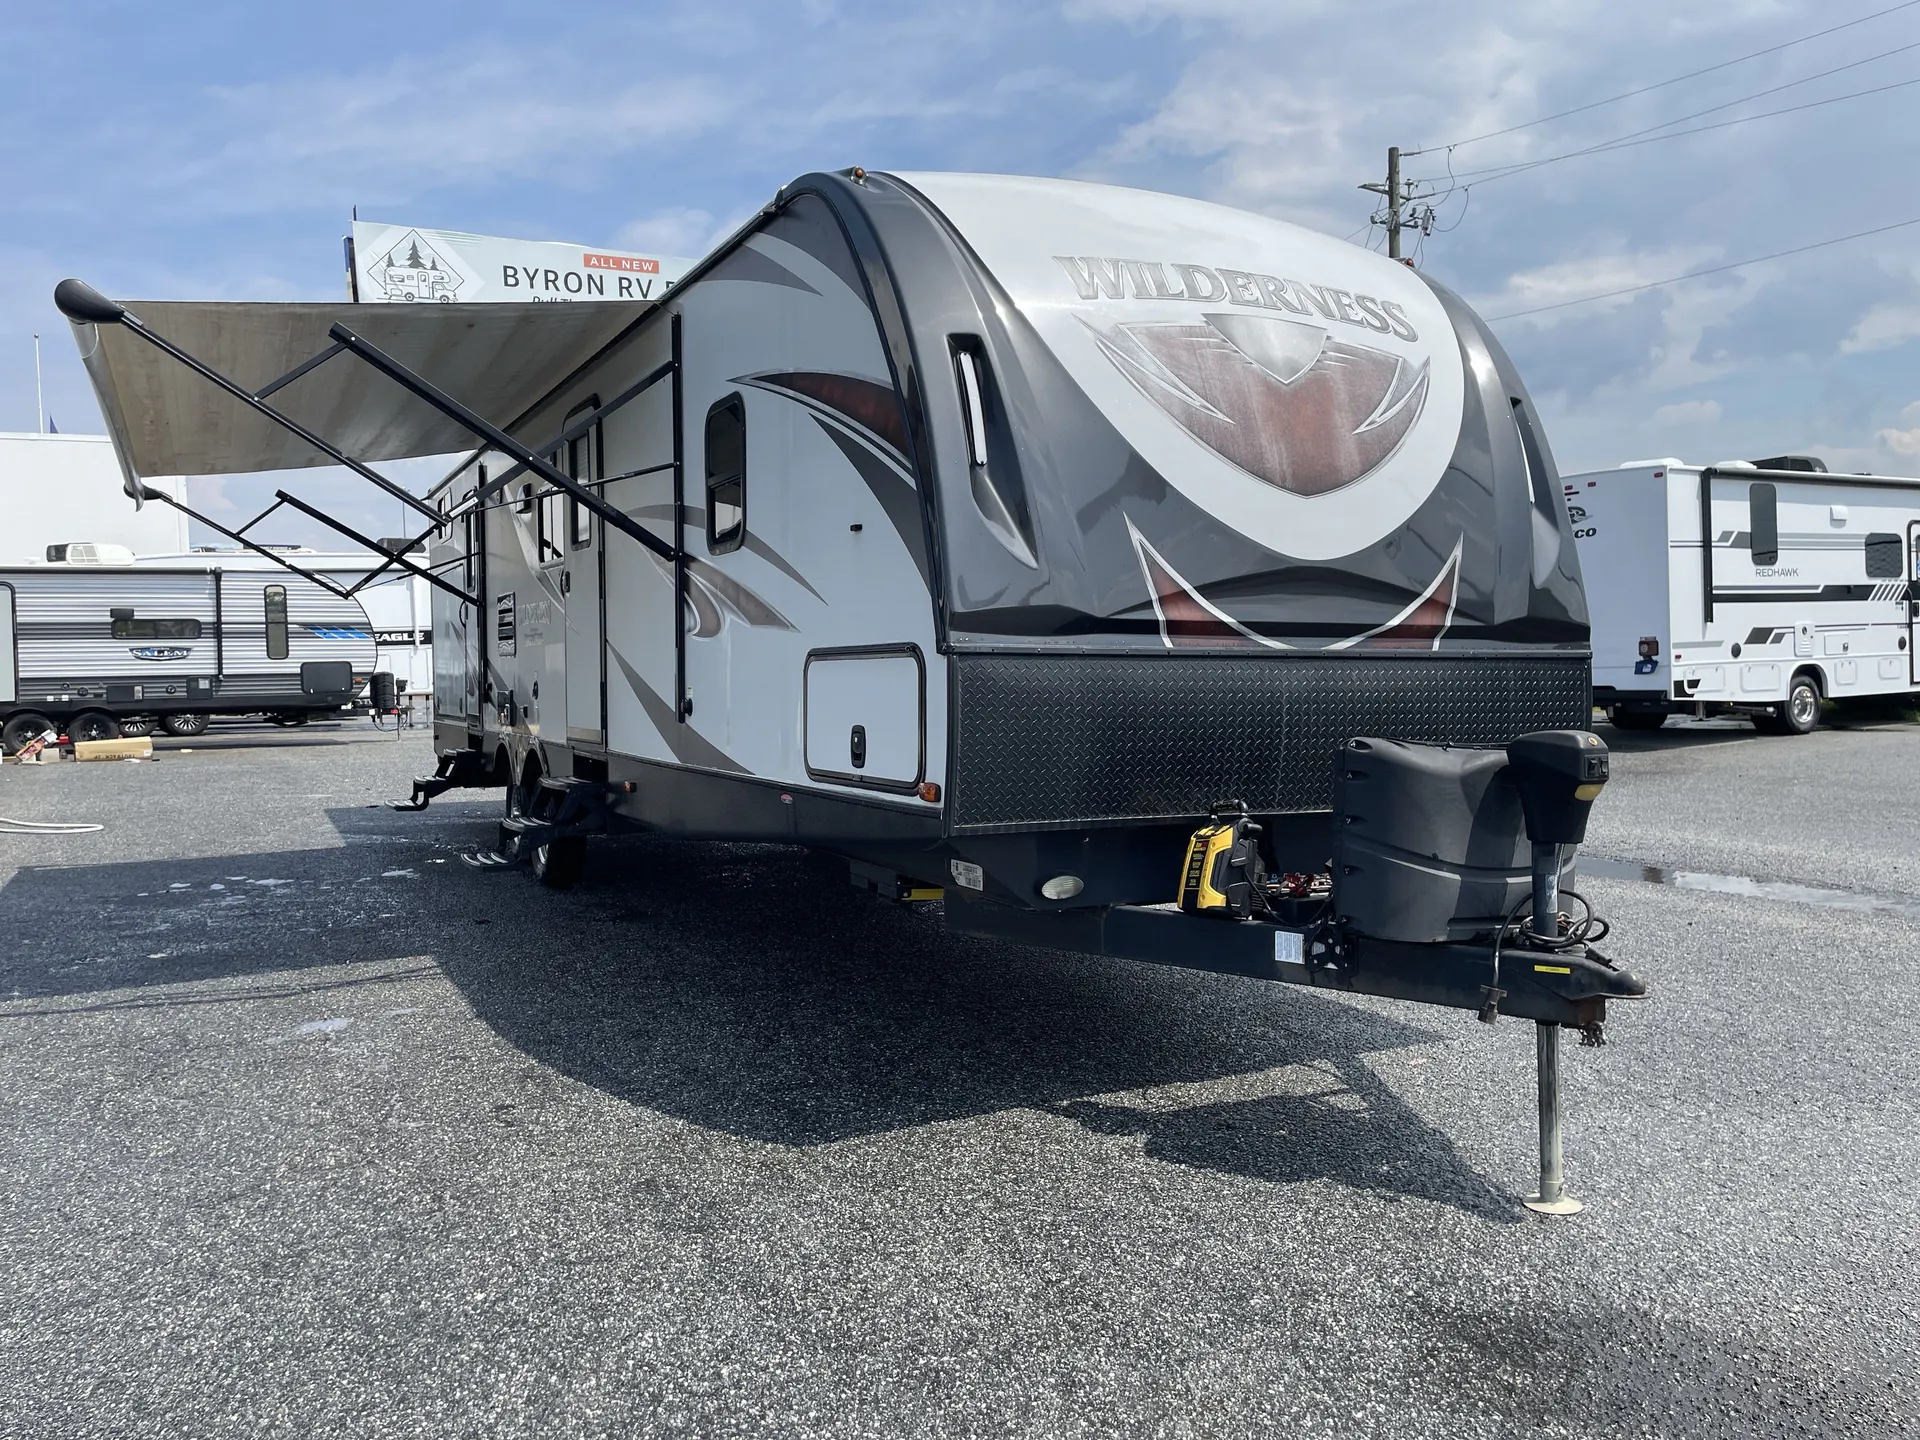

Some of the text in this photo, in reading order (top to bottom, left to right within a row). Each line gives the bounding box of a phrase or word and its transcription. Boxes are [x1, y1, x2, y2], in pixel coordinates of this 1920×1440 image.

[590, 257, 654, 271] ALL NEW
[503, 264, 604, 296] BYRON
[618, 276, 653, 300] RV
[1052, 256, 1419, 342] WILDERNESS
[1755, 568, 1799, 577] REDHAWK
[375, 632, 425, 642] EAGLE
[132, 649, 188, 657] SALEM
